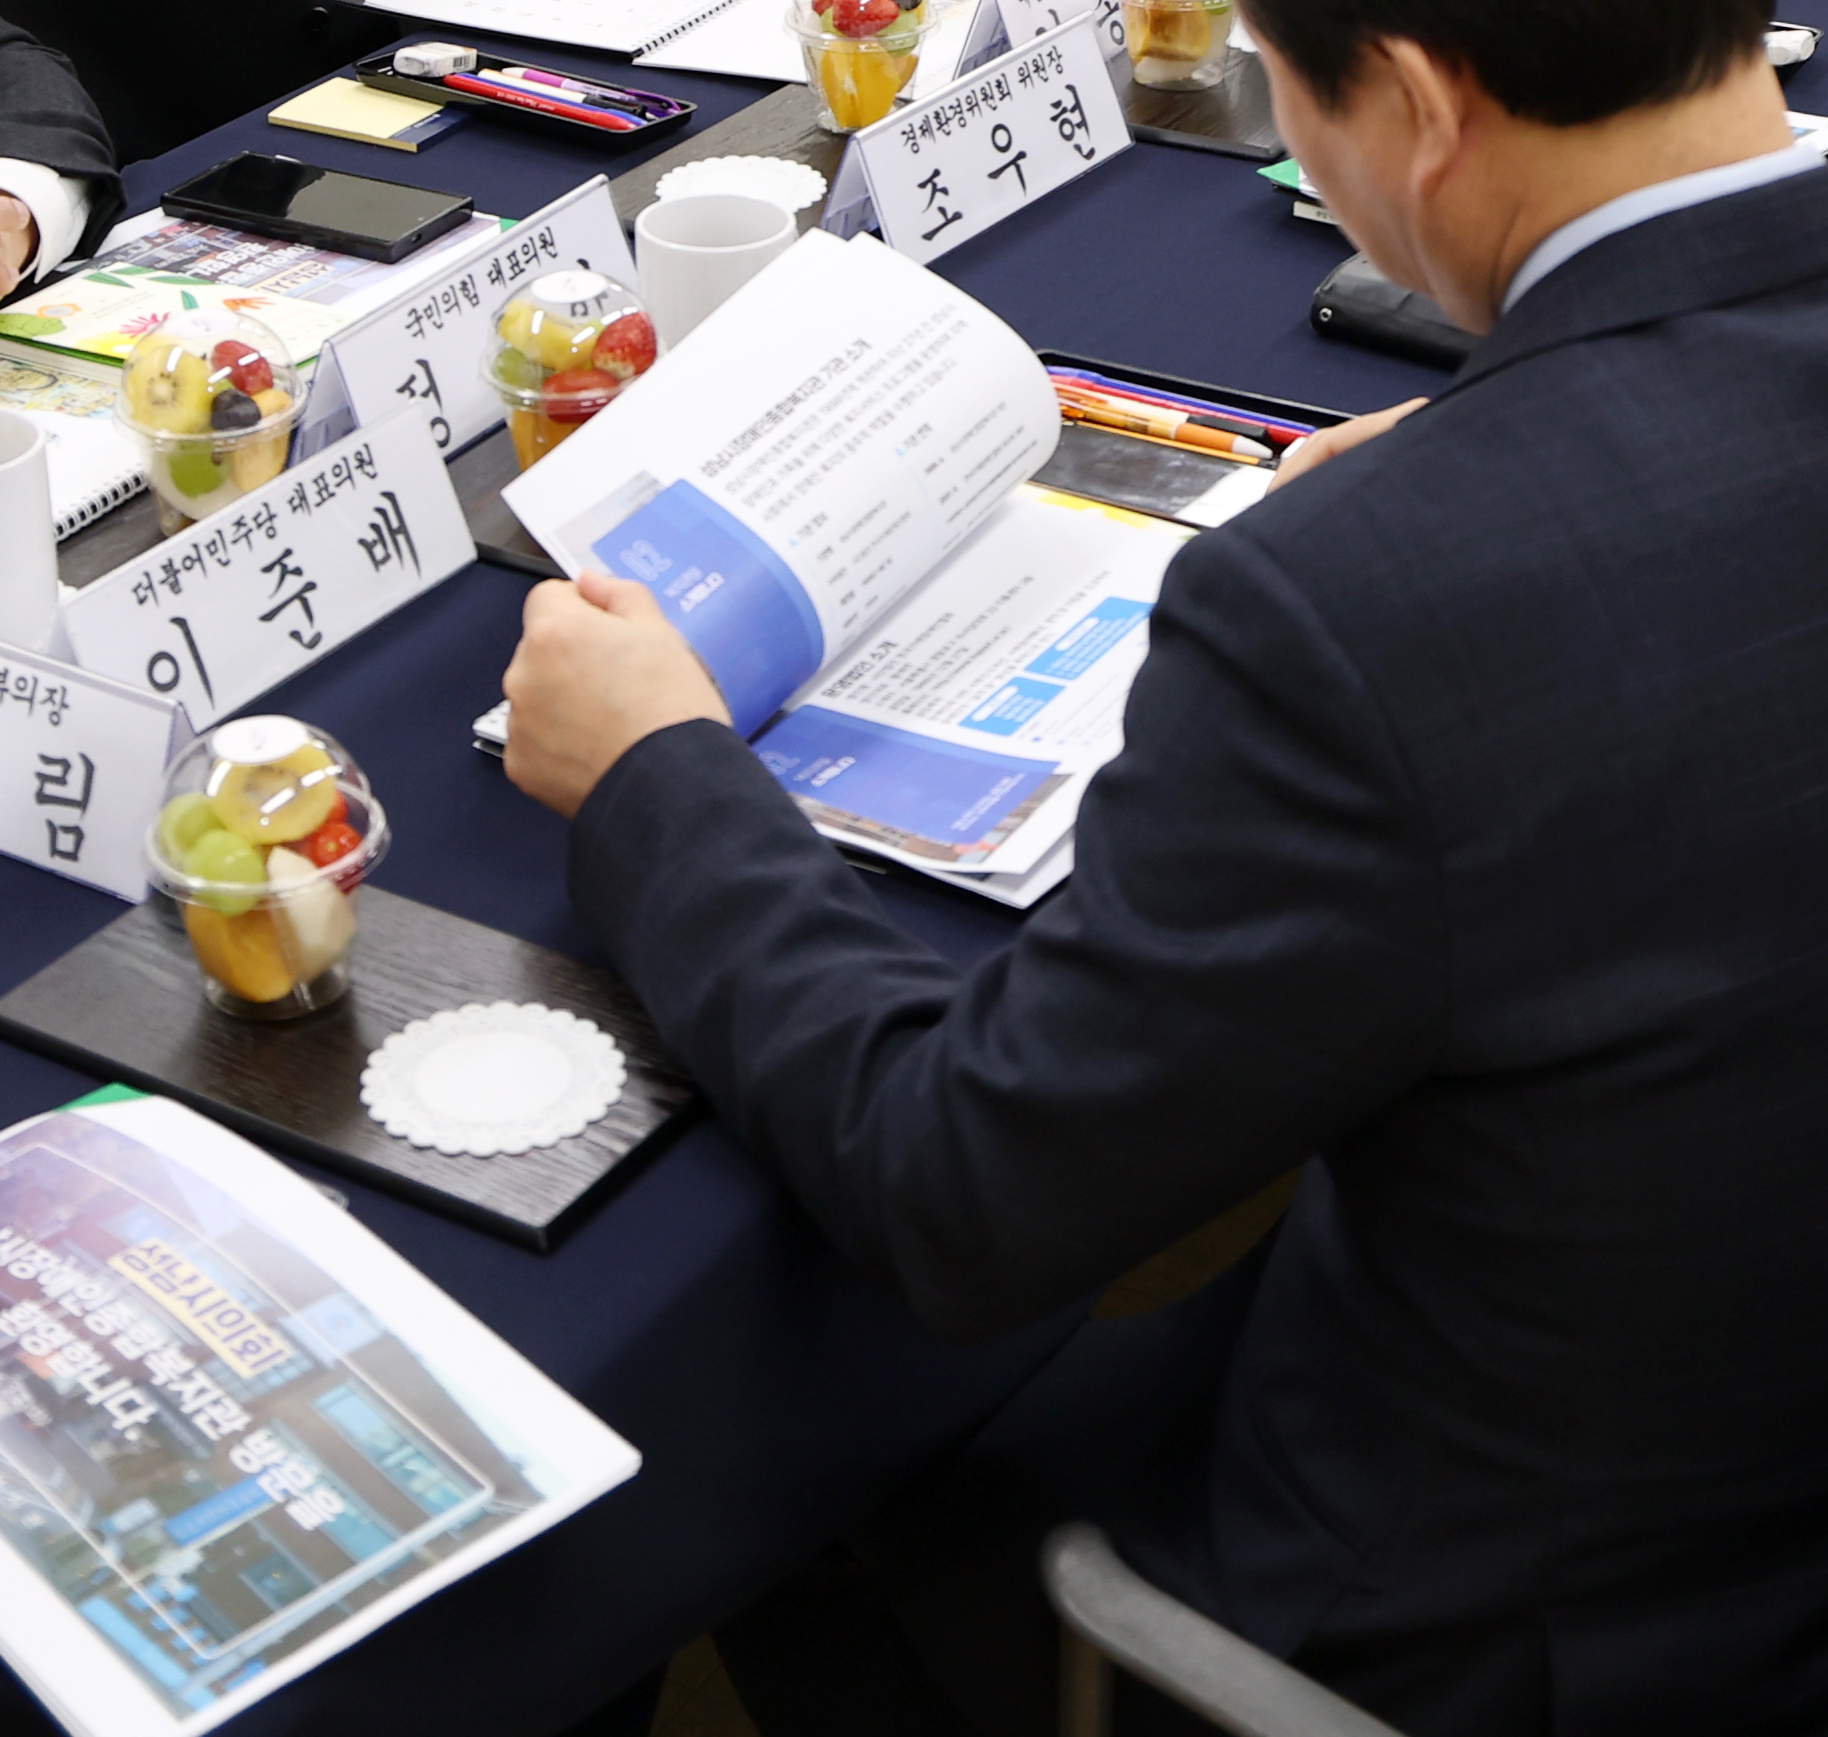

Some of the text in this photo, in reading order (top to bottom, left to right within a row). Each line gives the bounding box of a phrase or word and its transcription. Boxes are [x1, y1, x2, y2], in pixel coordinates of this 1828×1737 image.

[900, 46, 1063, 154] 경제환경위원회 위원장
[405, 275, 480, 339] 국민의힘
[487, 226, 558, 288] 대표의원
[133, 443, 378, 607] 더불어민주당 대표의원
[119, 1238, 297, 1371] 성남시의회
[226, 1428, 352, 1530] 방문을
